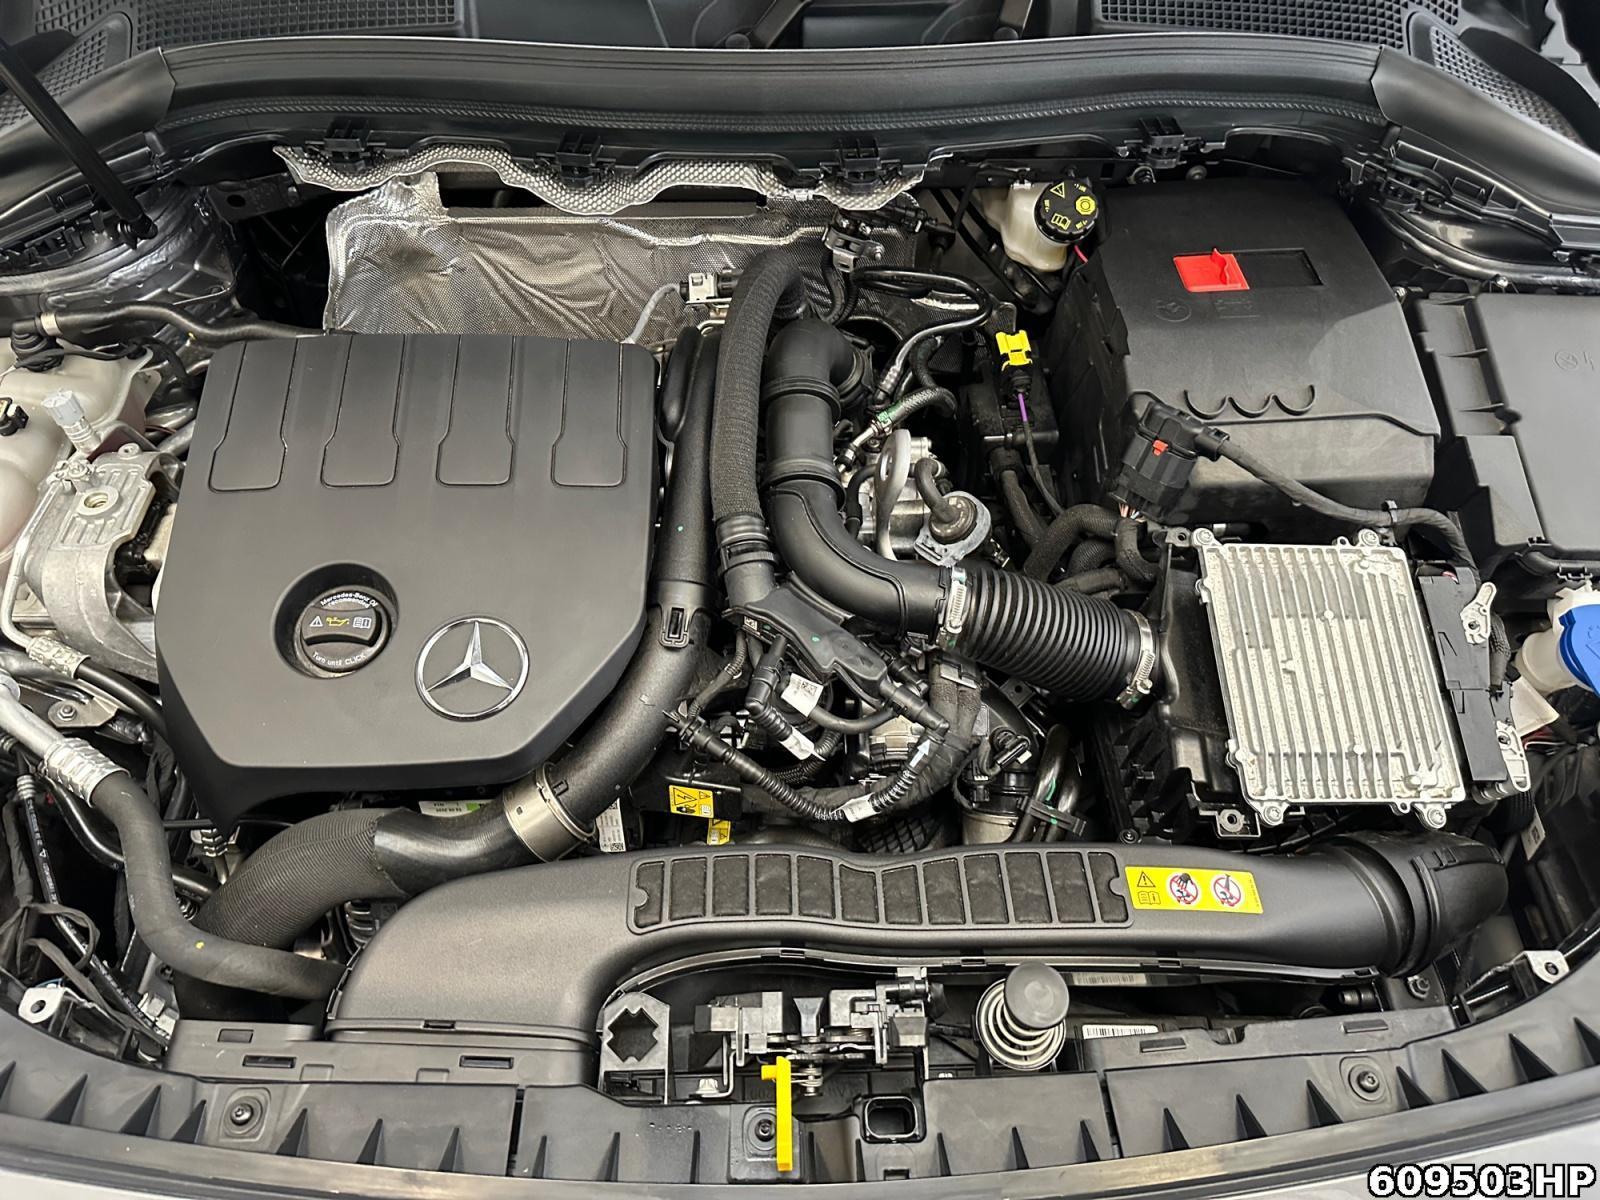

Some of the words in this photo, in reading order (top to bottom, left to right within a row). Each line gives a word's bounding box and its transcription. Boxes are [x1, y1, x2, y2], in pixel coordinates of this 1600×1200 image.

[320, 592, 370, 606] Mercedes-Benz
[312, 651, 326, 663] Turn
[345, 652, 366, 665] CLICK
